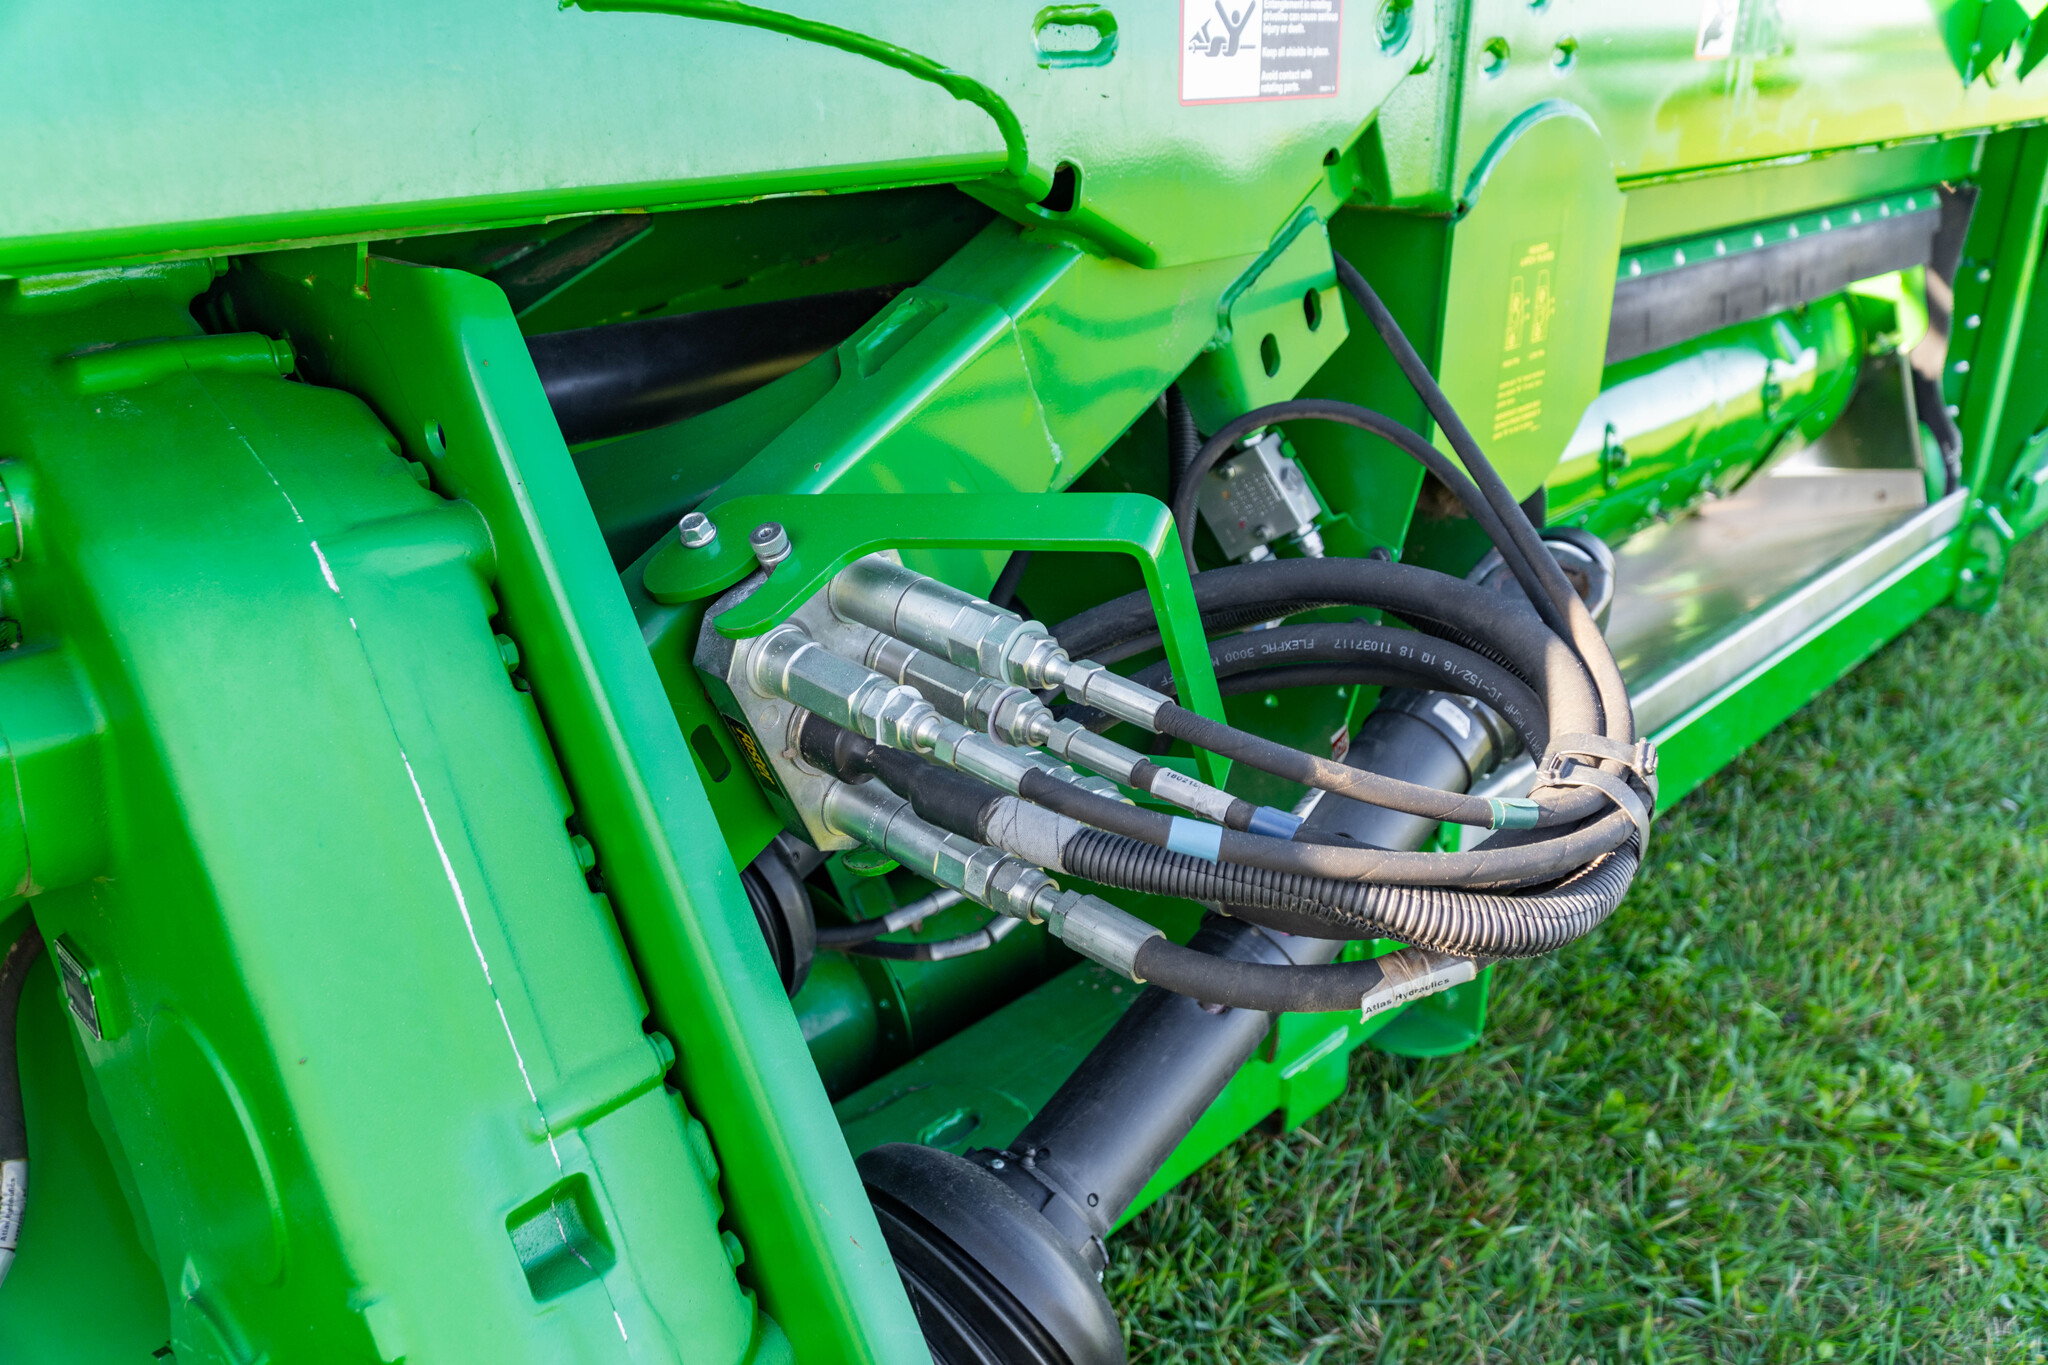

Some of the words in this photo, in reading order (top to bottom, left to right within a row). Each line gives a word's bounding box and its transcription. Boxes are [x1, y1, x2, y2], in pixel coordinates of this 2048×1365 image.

[1225, 647, 1255, 663] 3000
[1261, 639, 1314, 655] FLEXPAC
[1400, 646, 1414, 659] 18
[1365, 999, 1392, 1014] Atlas
[1395, 977, 1450, 1002] Hydraulics
